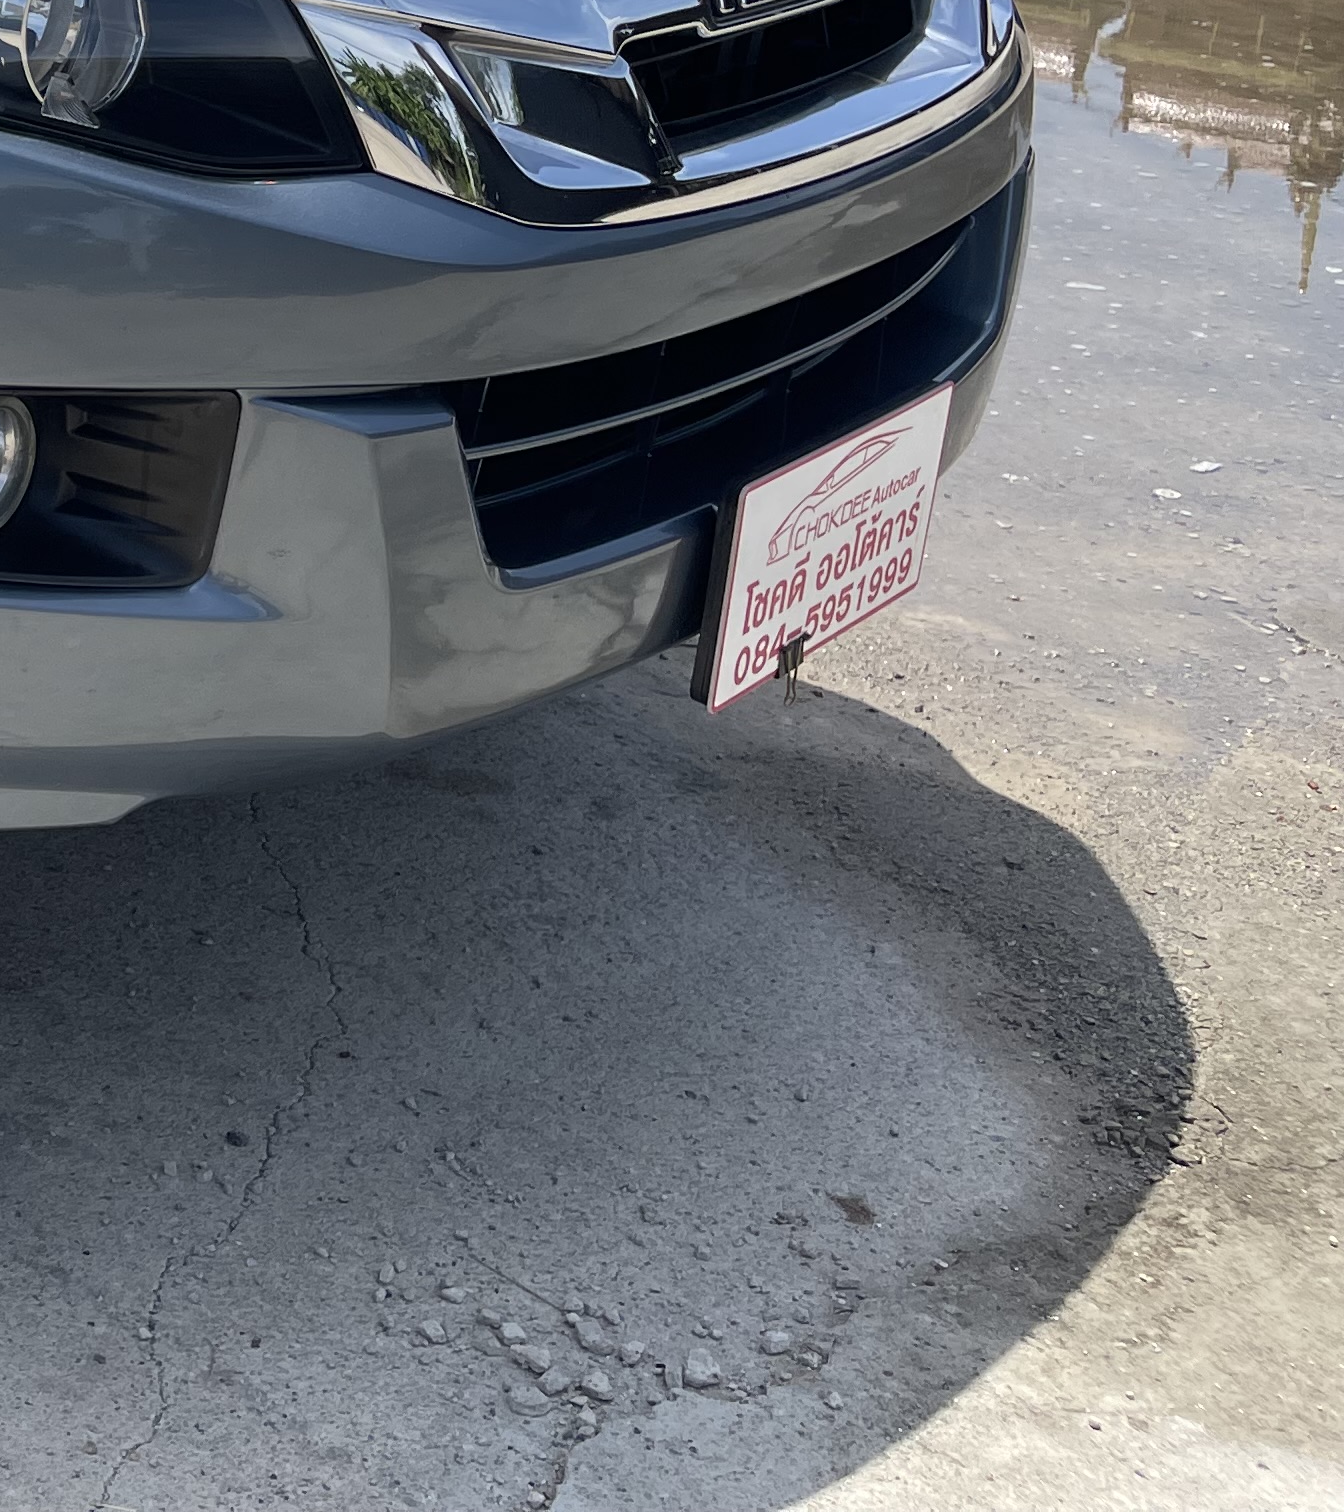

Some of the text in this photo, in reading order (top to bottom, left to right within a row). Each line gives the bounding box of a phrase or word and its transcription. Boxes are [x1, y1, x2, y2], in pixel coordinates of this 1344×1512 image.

[741, 484, 926, 636] โชคดี ออโต้คาร์
[793, 465, 922, 552] CHOKDEE Autocar
[733, 547, 913, 686] 084-5951999
